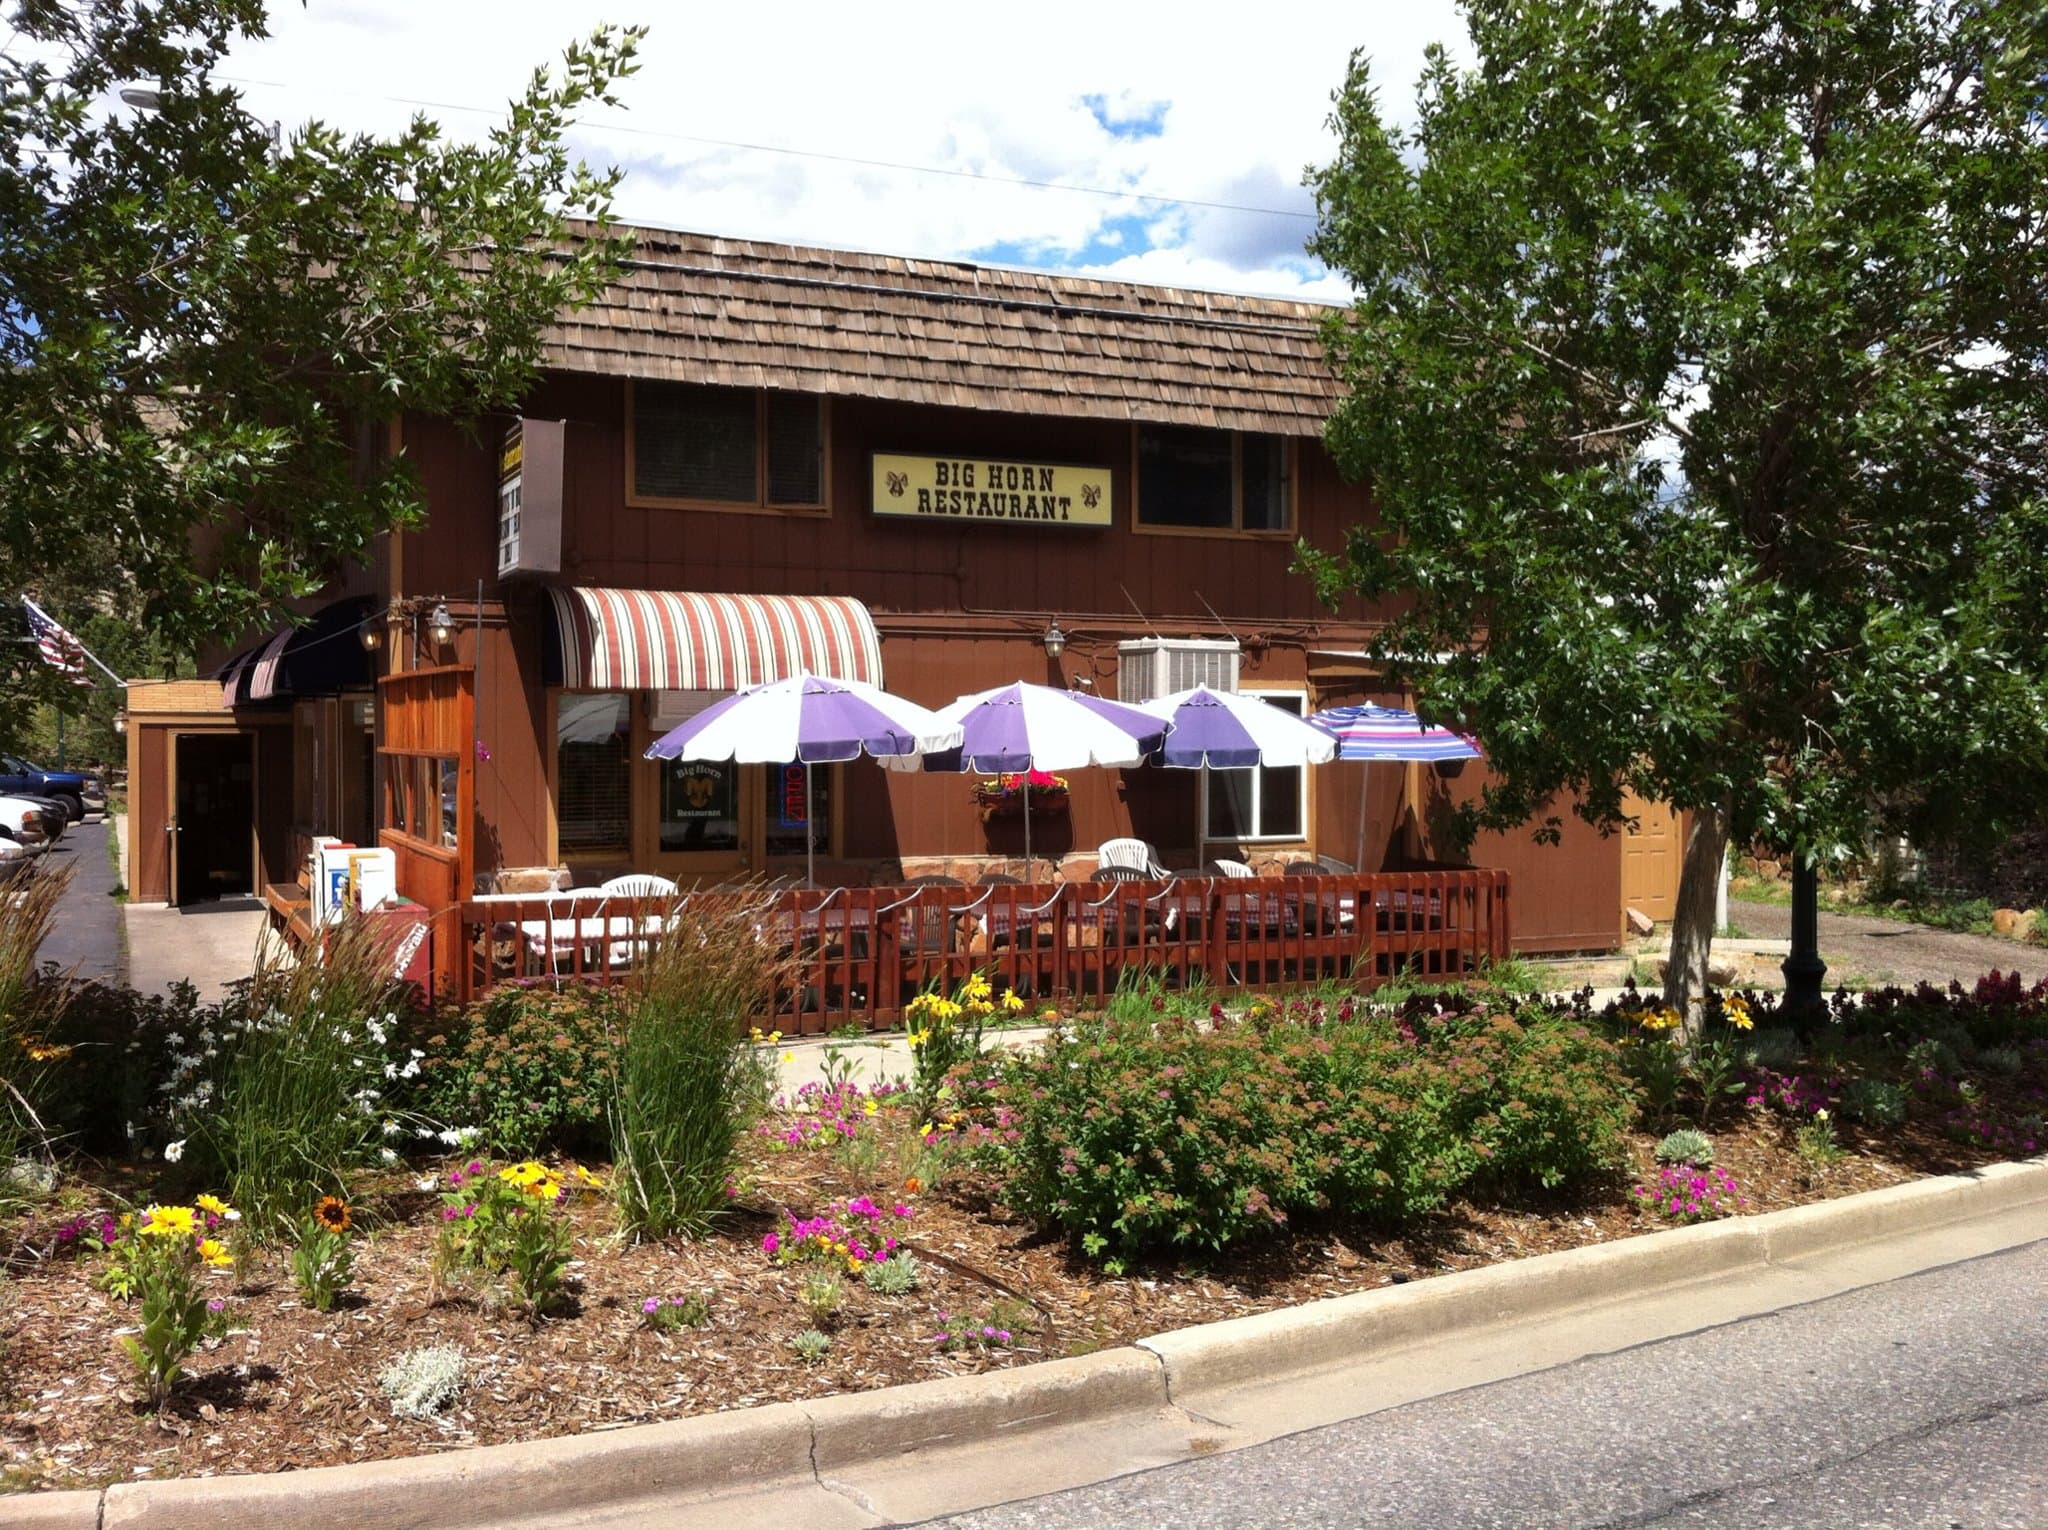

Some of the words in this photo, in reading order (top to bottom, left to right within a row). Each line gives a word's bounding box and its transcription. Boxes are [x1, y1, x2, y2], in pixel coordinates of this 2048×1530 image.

[935, 461, 975, 488] BIG
[988, 464, 1054, 492] HORN
[917, 488, 1072, 521] RESTAURANT
[676, 766, 696, 780] Big
[696, 764, 722, 780] Horn
[677, 808, 721, 817] Restaurant
